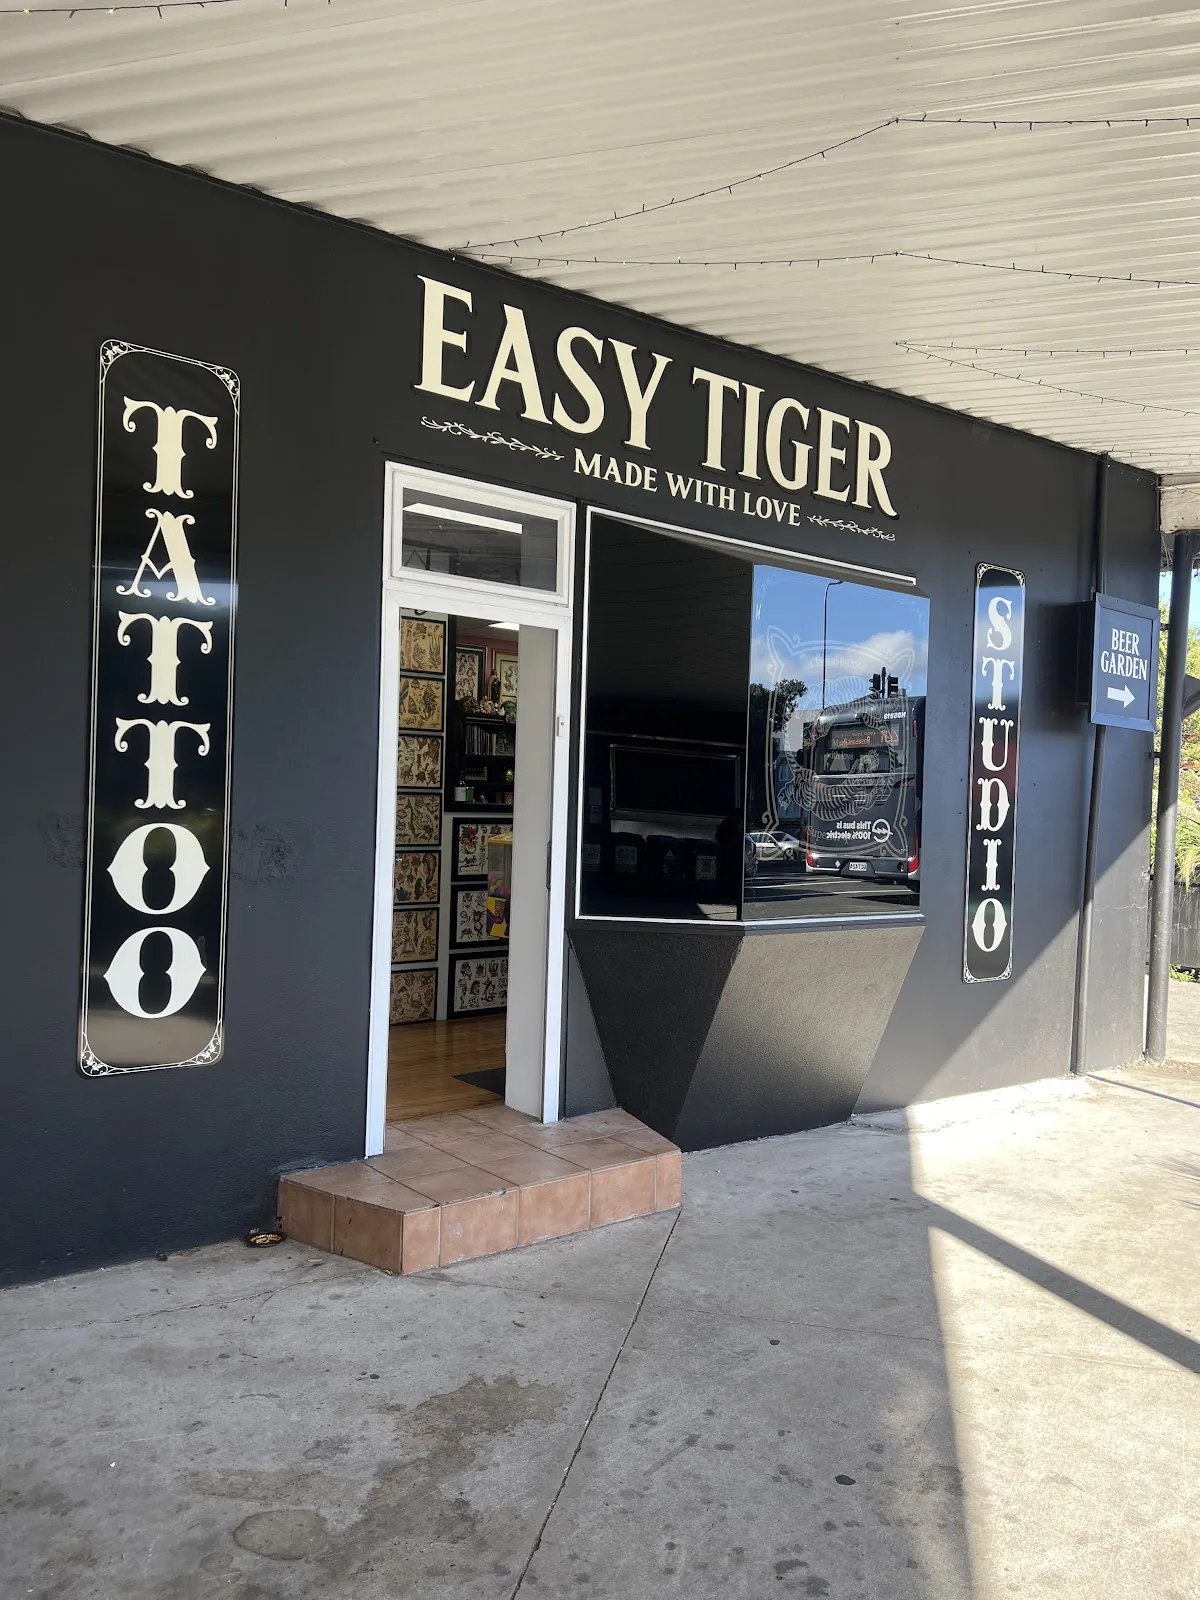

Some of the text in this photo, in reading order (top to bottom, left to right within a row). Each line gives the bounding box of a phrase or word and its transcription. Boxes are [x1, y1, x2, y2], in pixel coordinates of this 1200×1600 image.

[414, 274, 898, 517] EASY TIGER
[574, 447, 800, 527] MADE WITH LOVE
[103, 395, 219, 1019] TATTOO
[1100, 650, 1148, 681] GARDEN
[1111, 627, 1140, 656] BEER
[972, 596, 1015, 952] STUDIO
